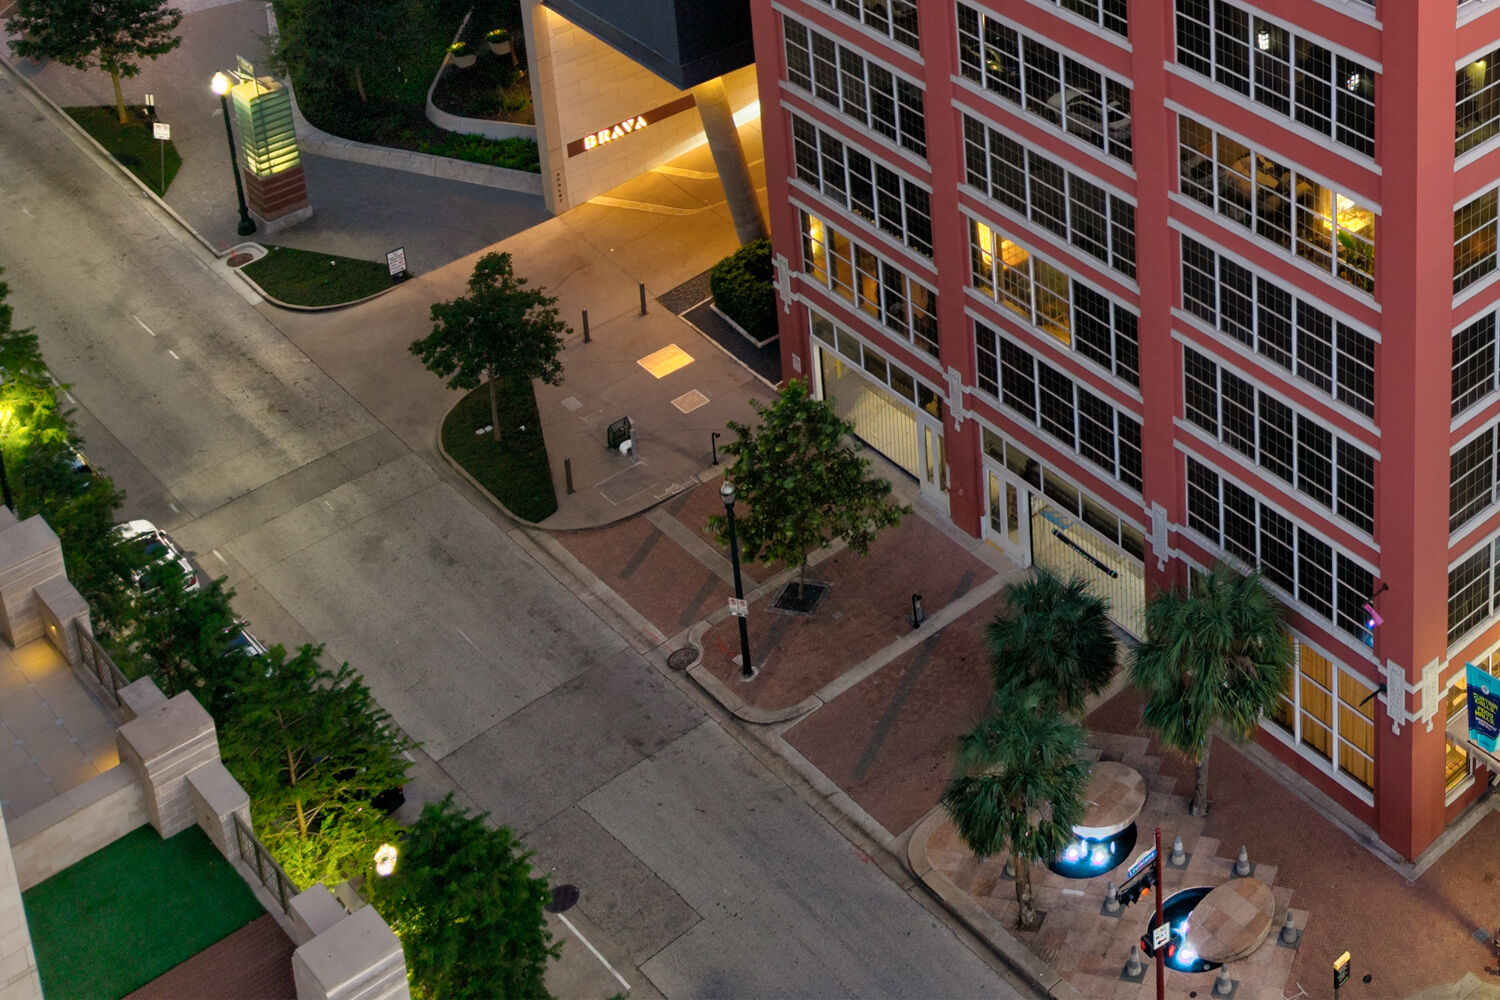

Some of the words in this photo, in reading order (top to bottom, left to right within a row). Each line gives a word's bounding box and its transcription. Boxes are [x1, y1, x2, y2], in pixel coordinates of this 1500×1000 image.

[583, 115, 648, 151] BRAVA
[1155, 925, 1167, 935] ONE
[1155, 931, 1167, 941] WAY
